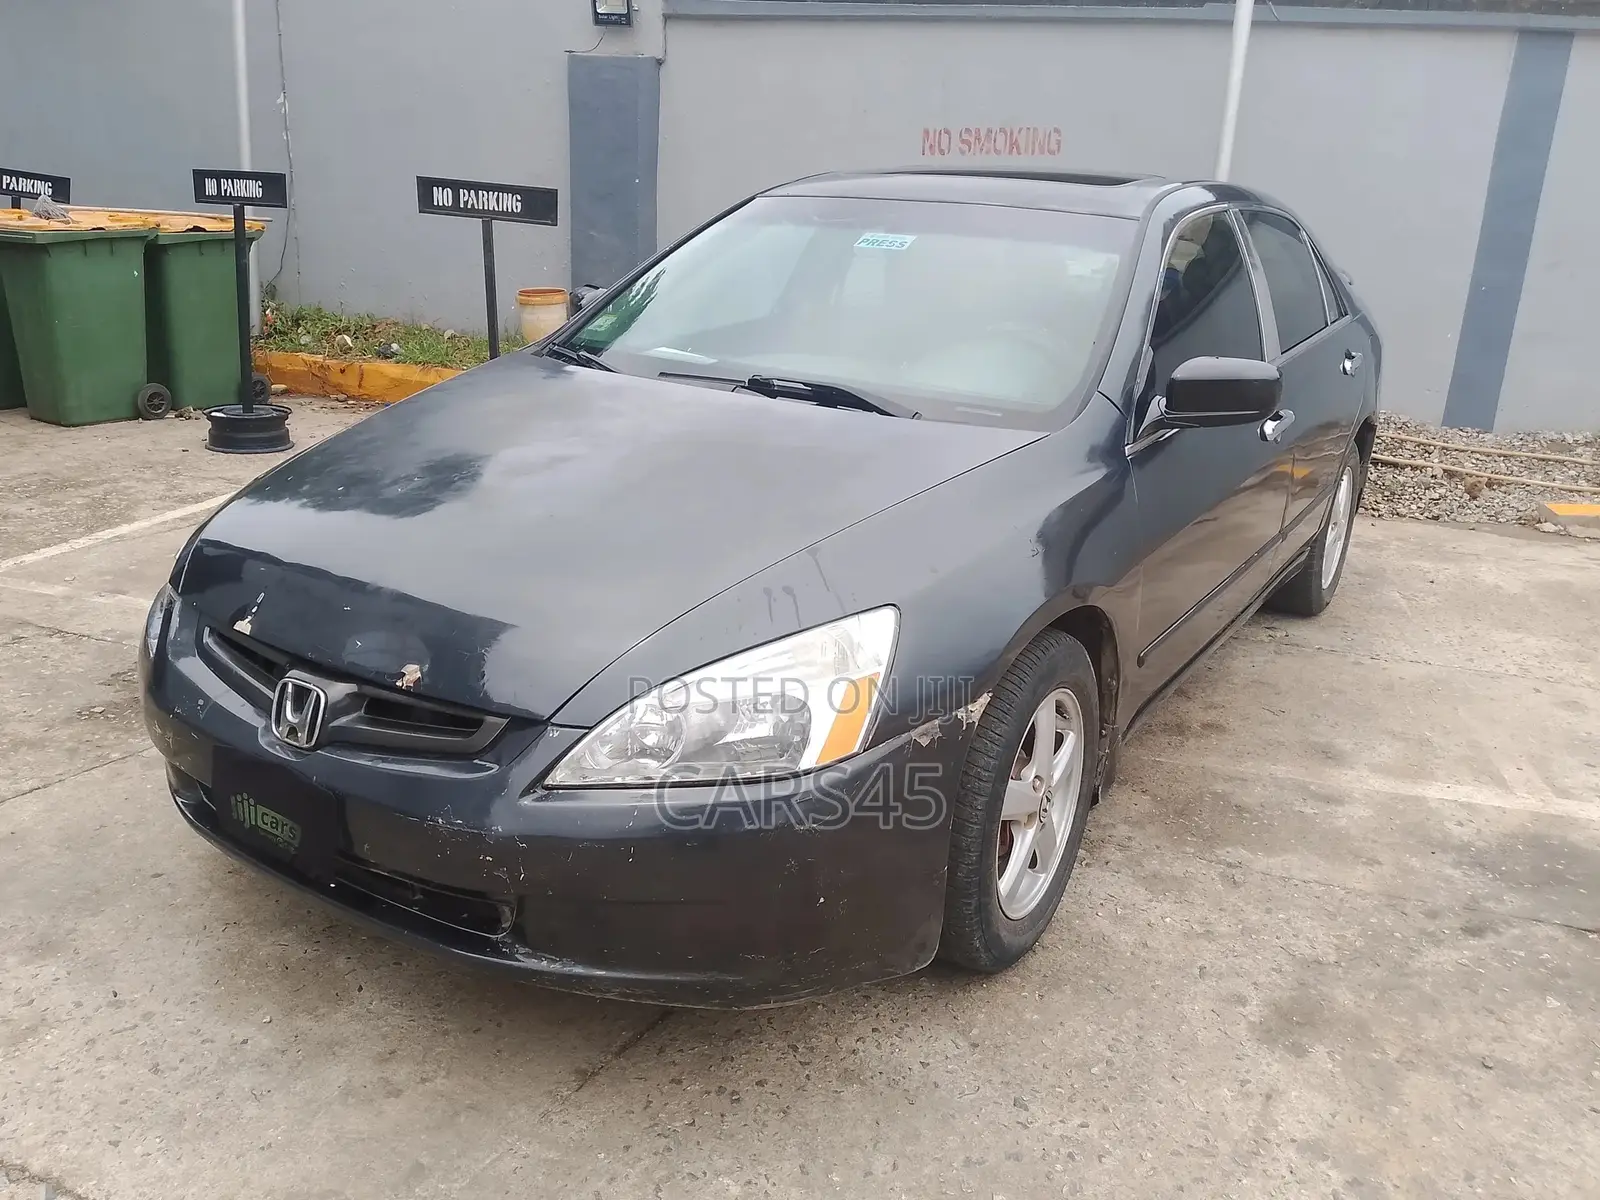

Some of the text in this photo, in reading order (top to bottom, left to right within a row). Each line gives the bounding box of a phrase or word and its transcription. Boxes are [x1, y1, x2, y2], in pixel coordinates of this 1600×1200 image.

[921, 127, 1062, 156] NO SMOKING
[2, 174, 53, 196] PARKING
[205, 177, 263, 199] NO PARKING
[432, 186, 522, 213] NO PARKING
[857, 238, 908, 249] PRESS
